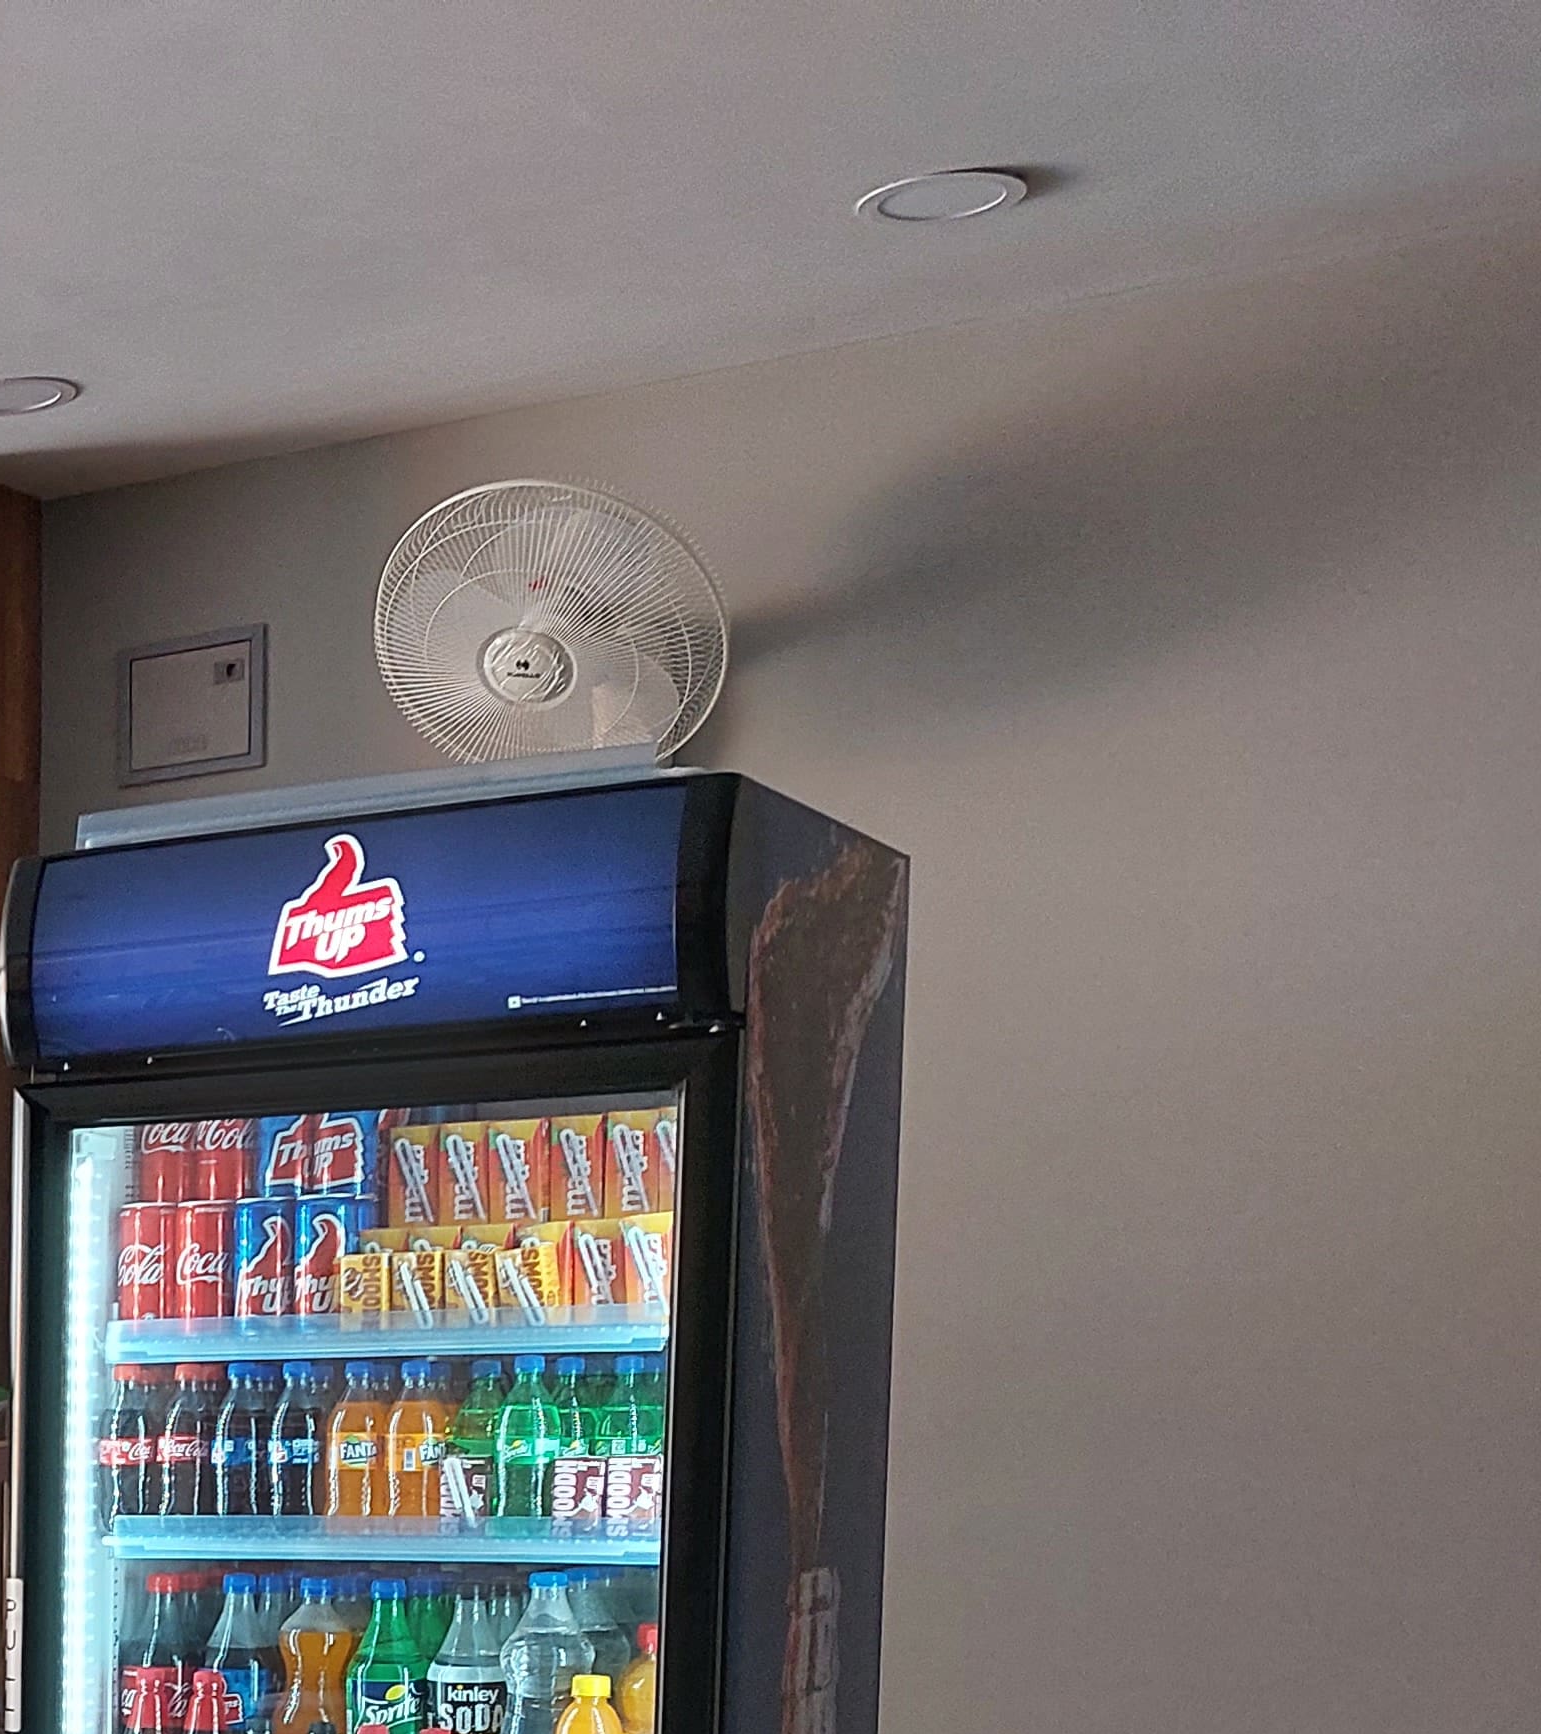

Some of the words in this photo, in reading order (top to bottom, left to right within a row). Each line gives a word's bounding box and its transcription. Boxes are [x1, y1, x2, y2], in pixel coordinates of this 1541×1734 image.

[286, 897, 393, 949] Thums
[314, 923, 366, 963] UP
[263, 984, 321, 1010] Taste
[283, 977, 419, 1023] Thunder
[339, 1440, 378, 1463] FANTA
[552, 1459, 578, 1538] SMOODH
[606, 1457, 633, 1537] SMOODH
[363, 1692, 421, 1727] Sprite
[447, 1684, 500, 1706] kinley
[437, 1702, 505, 1734] SODA
